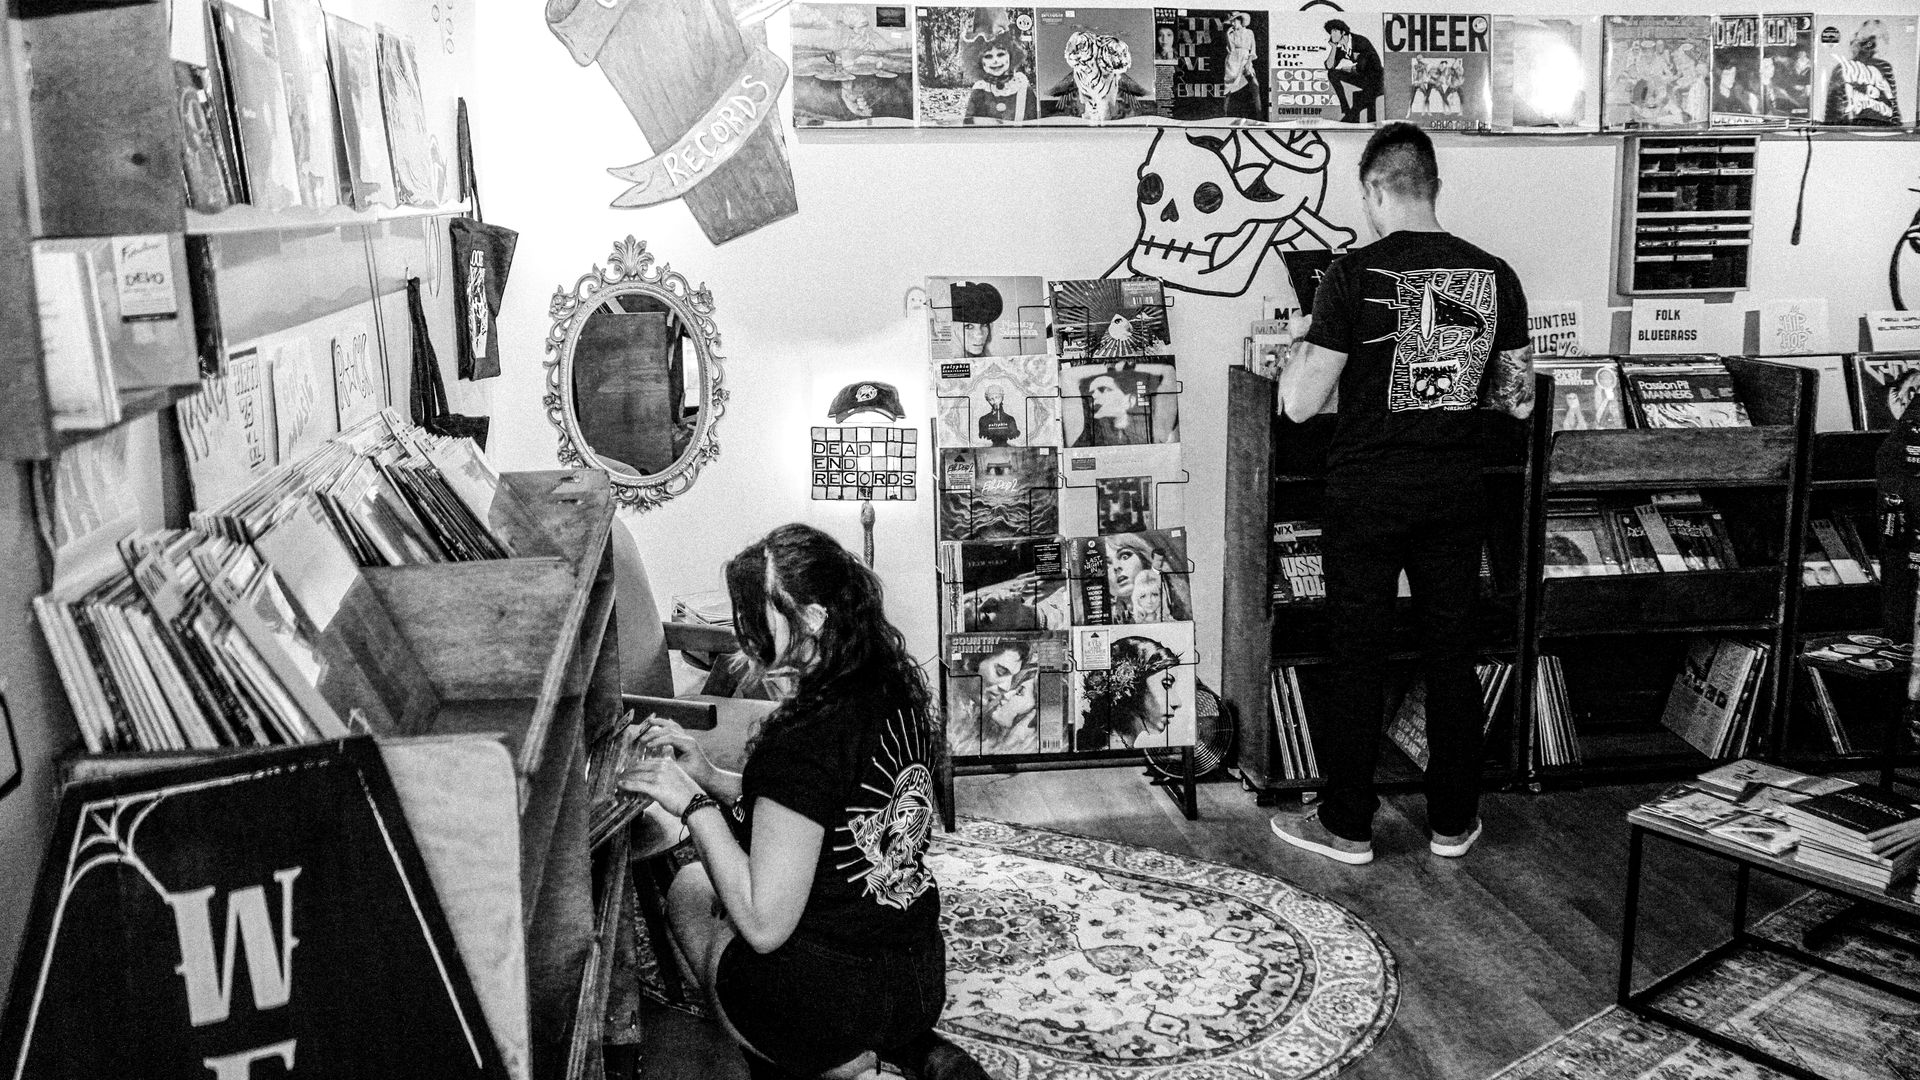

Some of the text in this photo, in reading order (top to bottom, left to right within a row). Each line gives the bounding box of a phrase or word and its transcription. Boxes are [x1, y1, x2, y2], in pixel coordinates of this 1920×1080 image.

[1385, 13, 1488, 52] CHEER
[1277, 93, 1341, 106] SOFA
[1278, 107, 1302, 115] COWBOY
[662, 74, 769, 186] RECORDS
[1655, 309, 1681, 321] FOLK
[1527, 312, 1577, 331] OUNTRY
[1638, 329, 1698, 341] BLUEGRASS
[1638, 380, 1690, 390] Passion Pit
[1641, 389, 1695, 400] MANNERS
[813, 443, 871, 455] DEAD
[814, 458, 856, 469] END
[814, 472, 914, 485] RECORDS
[951, 636, 1001, 645] COUNTRY
